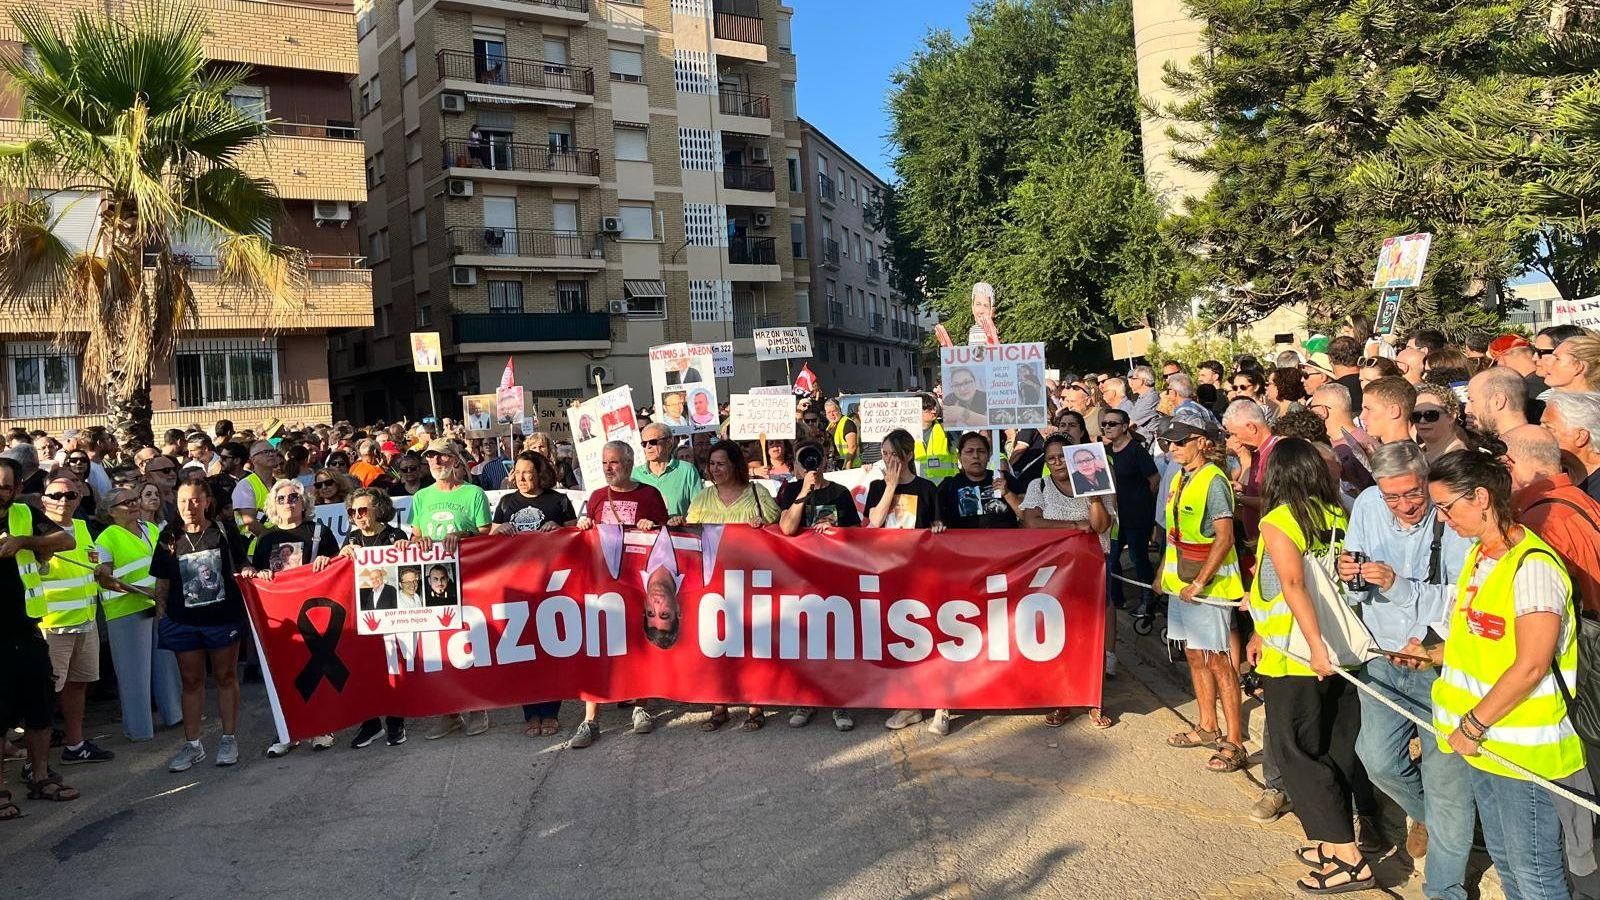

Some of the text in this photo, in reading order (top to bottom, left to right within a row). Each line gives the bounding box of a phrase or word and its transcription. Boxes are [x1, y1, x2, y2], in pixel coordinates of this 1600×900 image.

[755, 328, 805, 339] MAZON INUTIL
[768, 338, 800, 346] DIMISION
[720, 345, 731, 353] 322
[766, 345, 807, 354] Y PRISION
[650, 349, 678, 361] VICTIMAS
[719, 366, 734, 374] 19:50
[863, 400, 889, 409] CUANDO
[541, 410, 556, 418] SIN
[747, 408, 790, 420] JUSTICIA
[864, 409, 874, 417] NO
[550, 422, 570, 432] FAM
[738, 422, 793, 434] ASESINOS
[863, 425, 873, 434] LA
[358, 545, 456, 566] JUSTICIA
[384, 565, 1066, 676] Mazón dimissió
